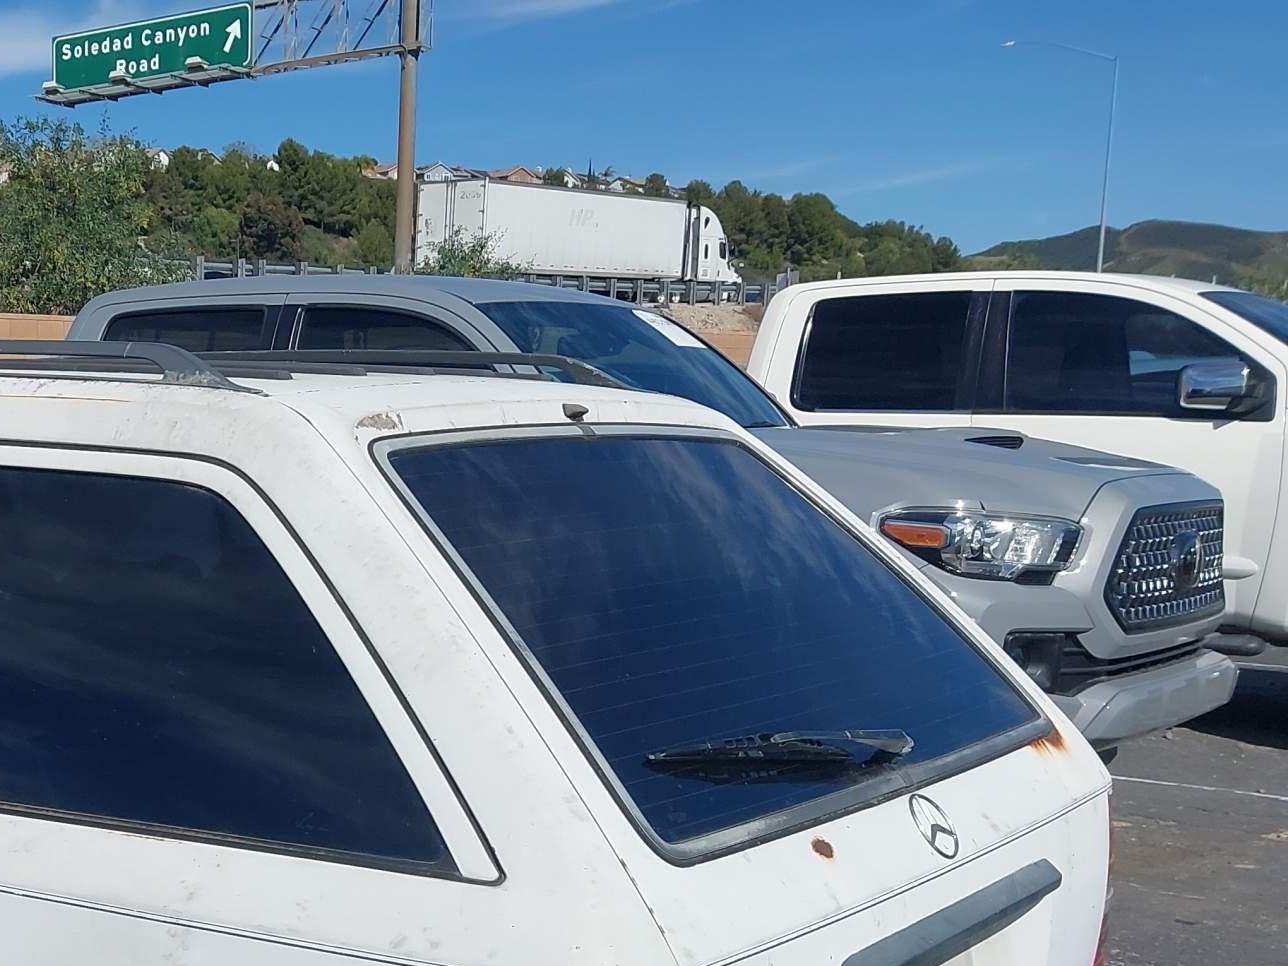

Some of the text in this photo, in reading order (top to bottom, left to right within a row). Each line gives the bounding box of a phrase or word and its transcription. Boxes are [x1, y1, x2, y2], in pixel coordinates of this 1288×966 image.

[61, 21, 210, 60] Soledad Canyon
[115, 53, 160, 74] Road
